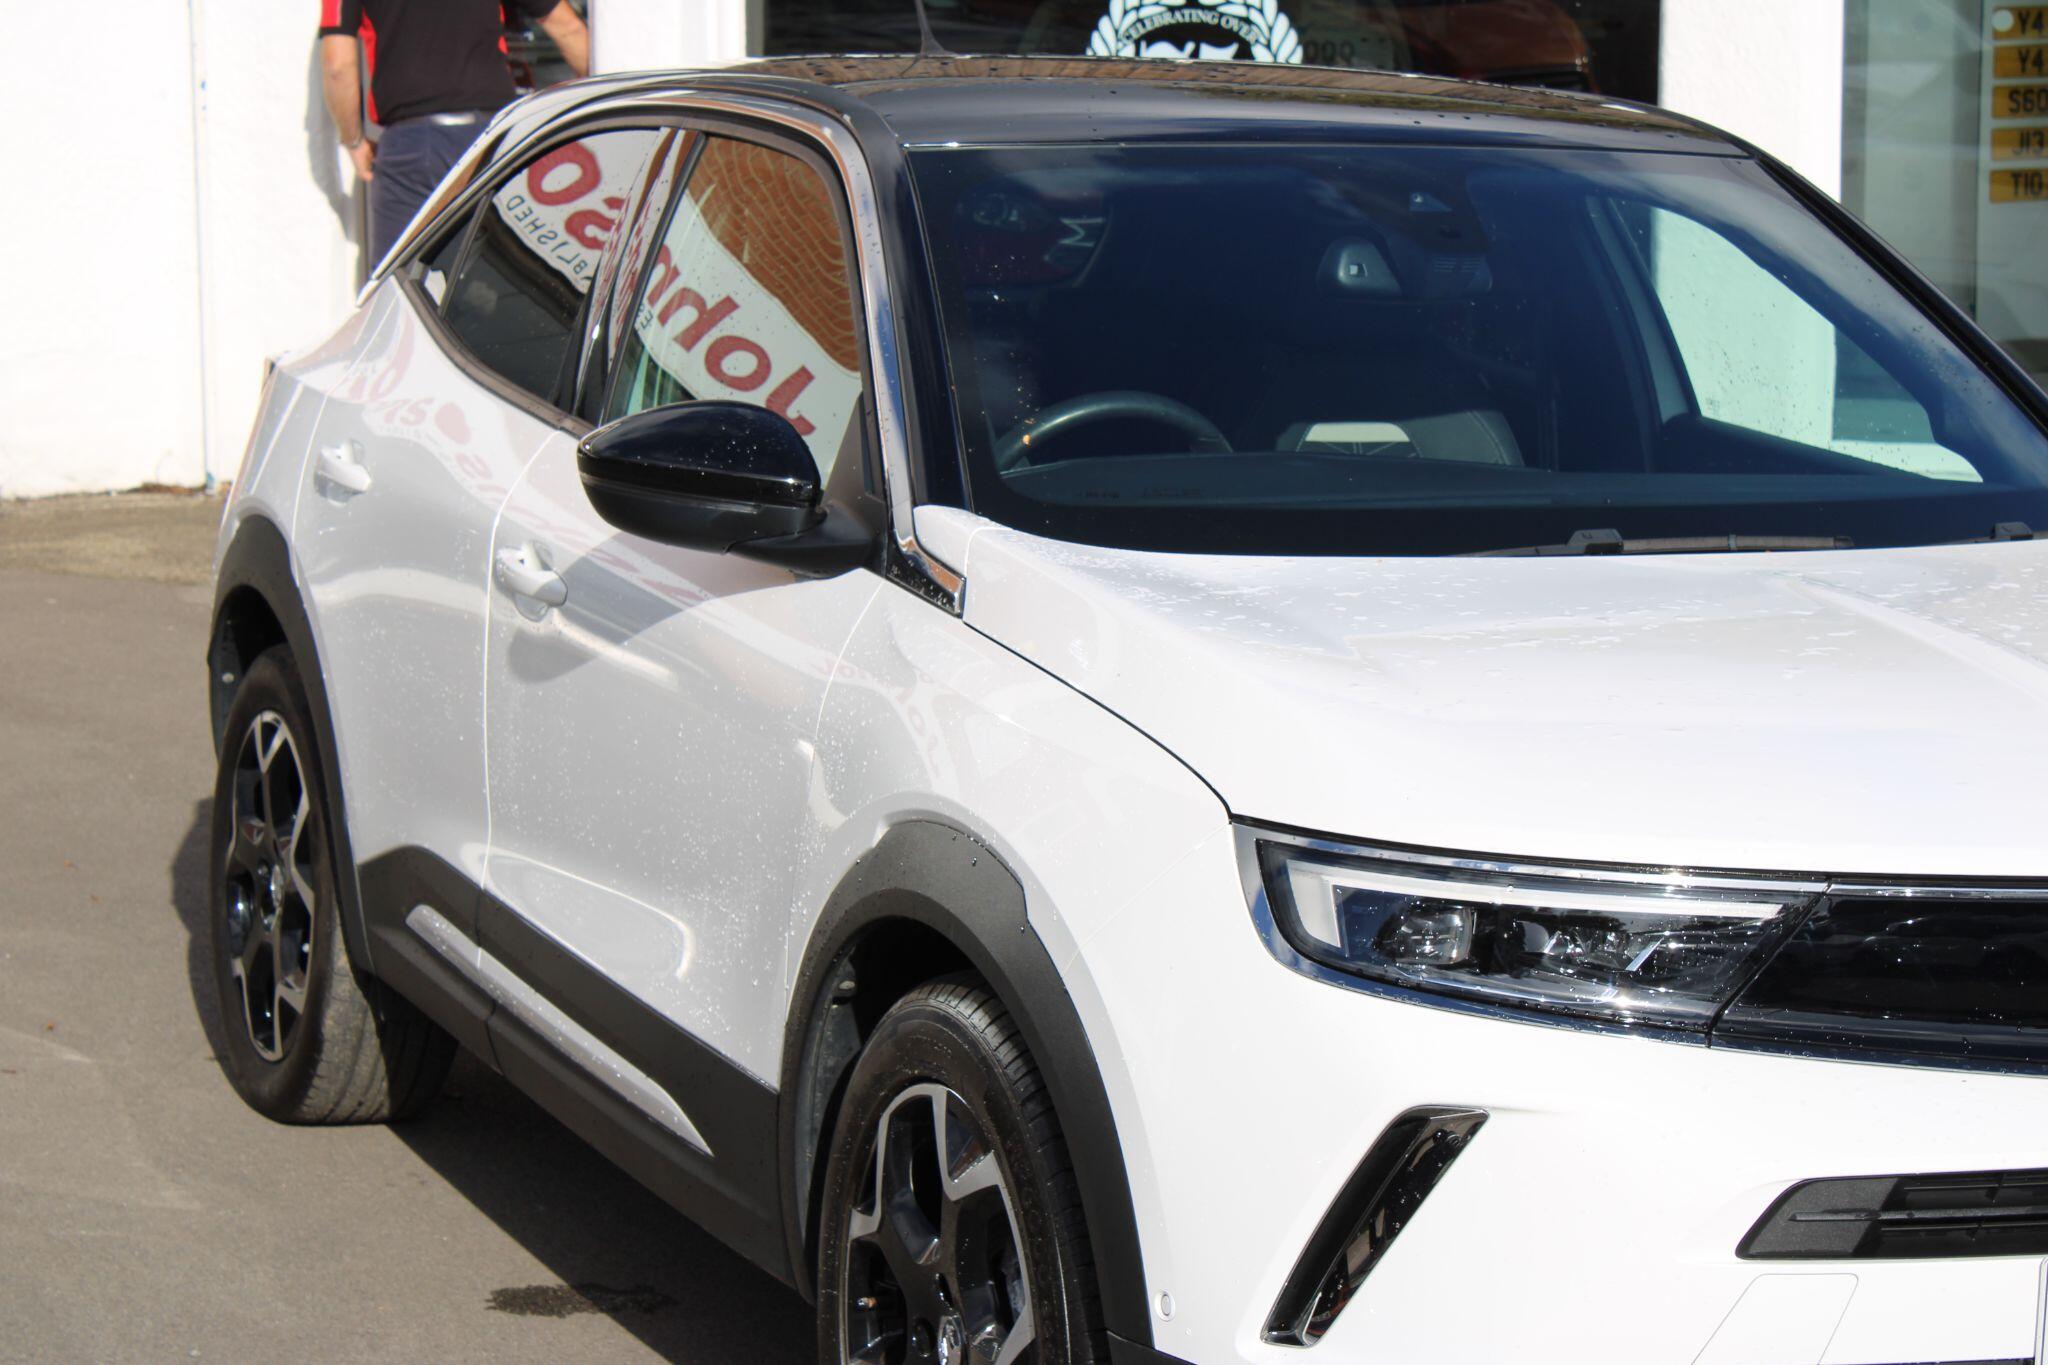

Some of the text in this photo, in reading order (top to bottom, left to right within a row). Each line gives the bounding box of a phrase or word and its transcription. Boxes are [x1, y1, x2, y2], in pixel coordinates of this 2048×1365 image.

[1120, 8, 1261, 44] CELEBRATING OVER
[2018, 48, 2044, 73] Y4
